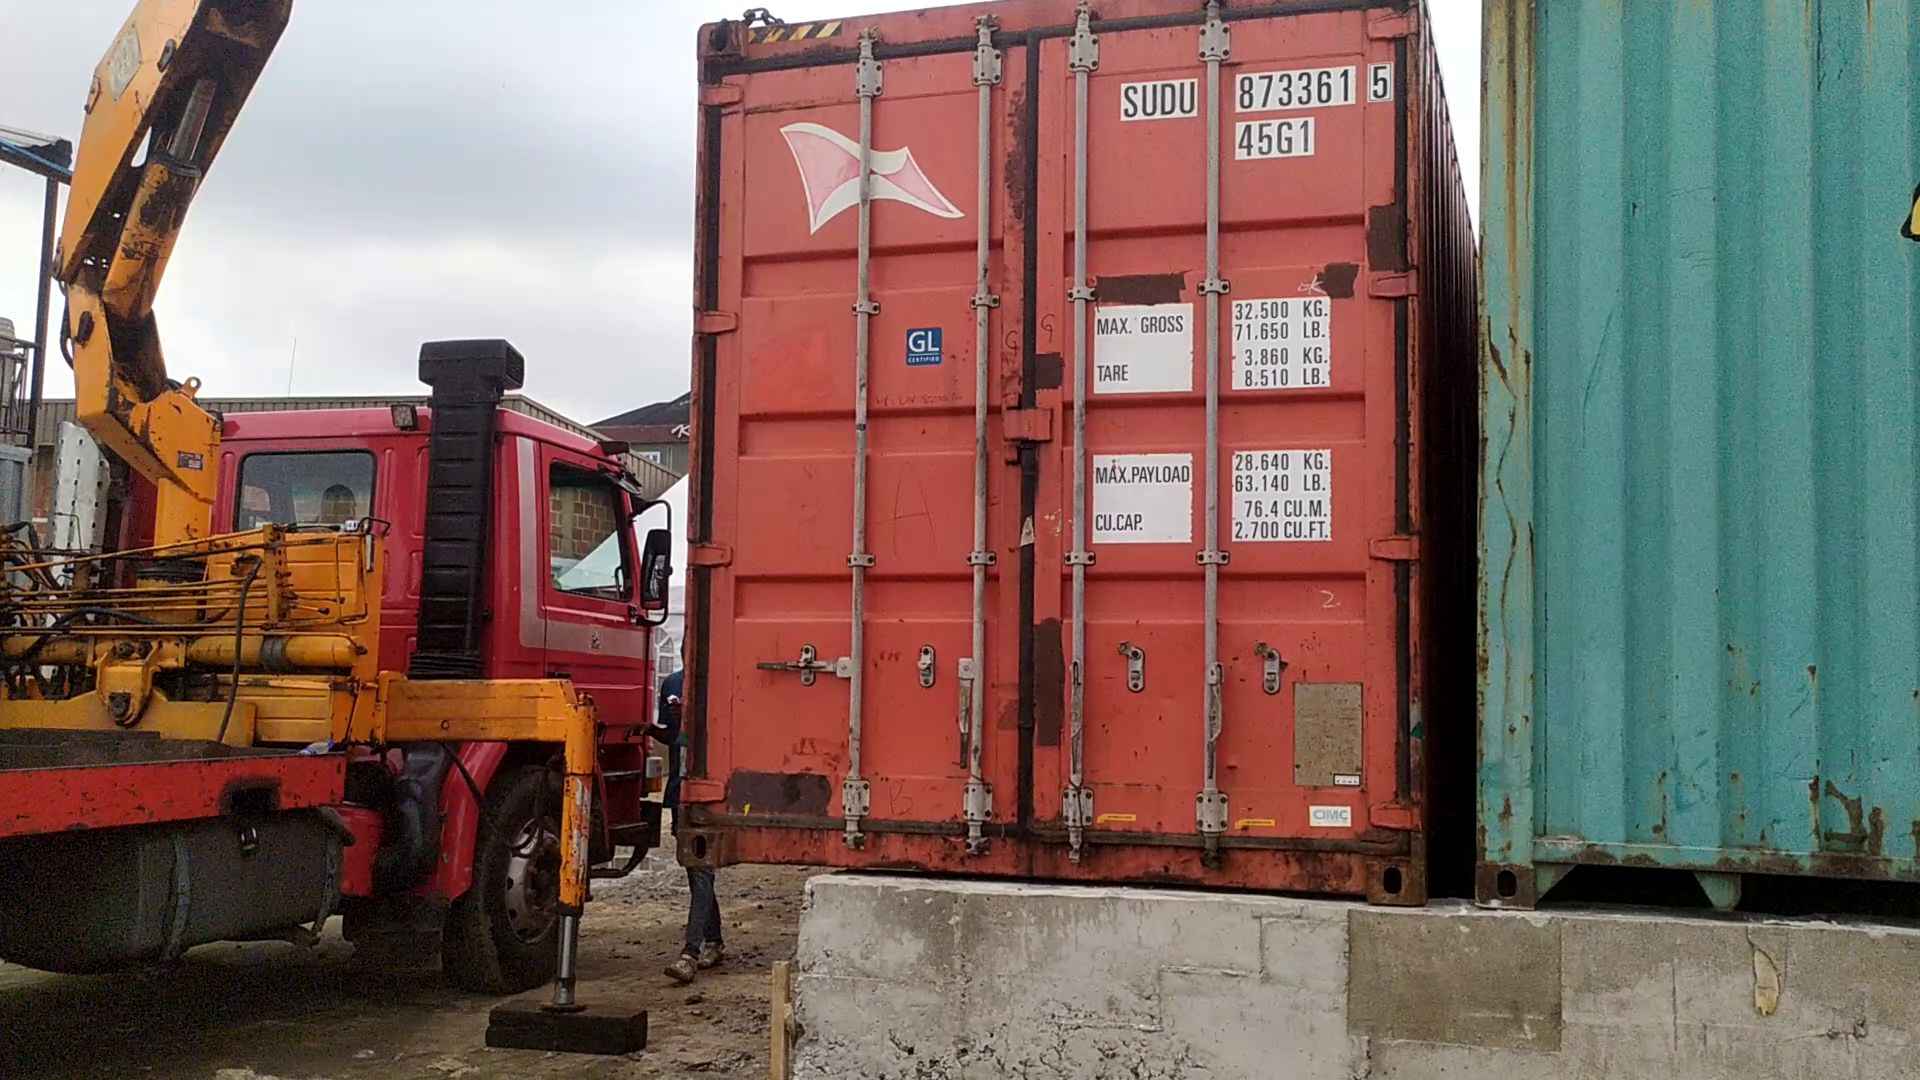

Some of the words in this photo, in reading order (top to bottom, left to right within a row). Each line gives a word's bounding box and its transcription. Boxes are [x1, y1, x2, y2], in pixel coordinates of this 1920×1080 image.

[1123, 81, 1196, 118] SUDU
[1239, 68, 1350, 110] 873361
[1373, 66, 1388, 99] 5
[1238, 120, 1310, 156] 45G1
[1303, 299, 1328, 318] KG.
[1097, 318, 1132, 335] MAX.
[1141, 315, 1184, 333] GROSS
[1303, 321, 1326, 339] LB.
[908, 330, 940, 353] GL
[1303, 346, 1328, 364] KG.
[1096, 364, 1129, 382] TARE
[1303, 367, 1326, 385] LB.
[1303, 452, 1328, 470] KG.
[1095, 465, 1190, 484] MAX.PAYLOAD
[1303, 473, 1326, 491] LB.
[1244, 500, 1278, 518] 76.4
[1284, 500, 1327, 518] CU.M.
[1095, 513, 1143, 531] CU.CAP.
[1284, 520, 1328, 538] CU.FT.
[1312, 808, 1349, 821] CIMC
